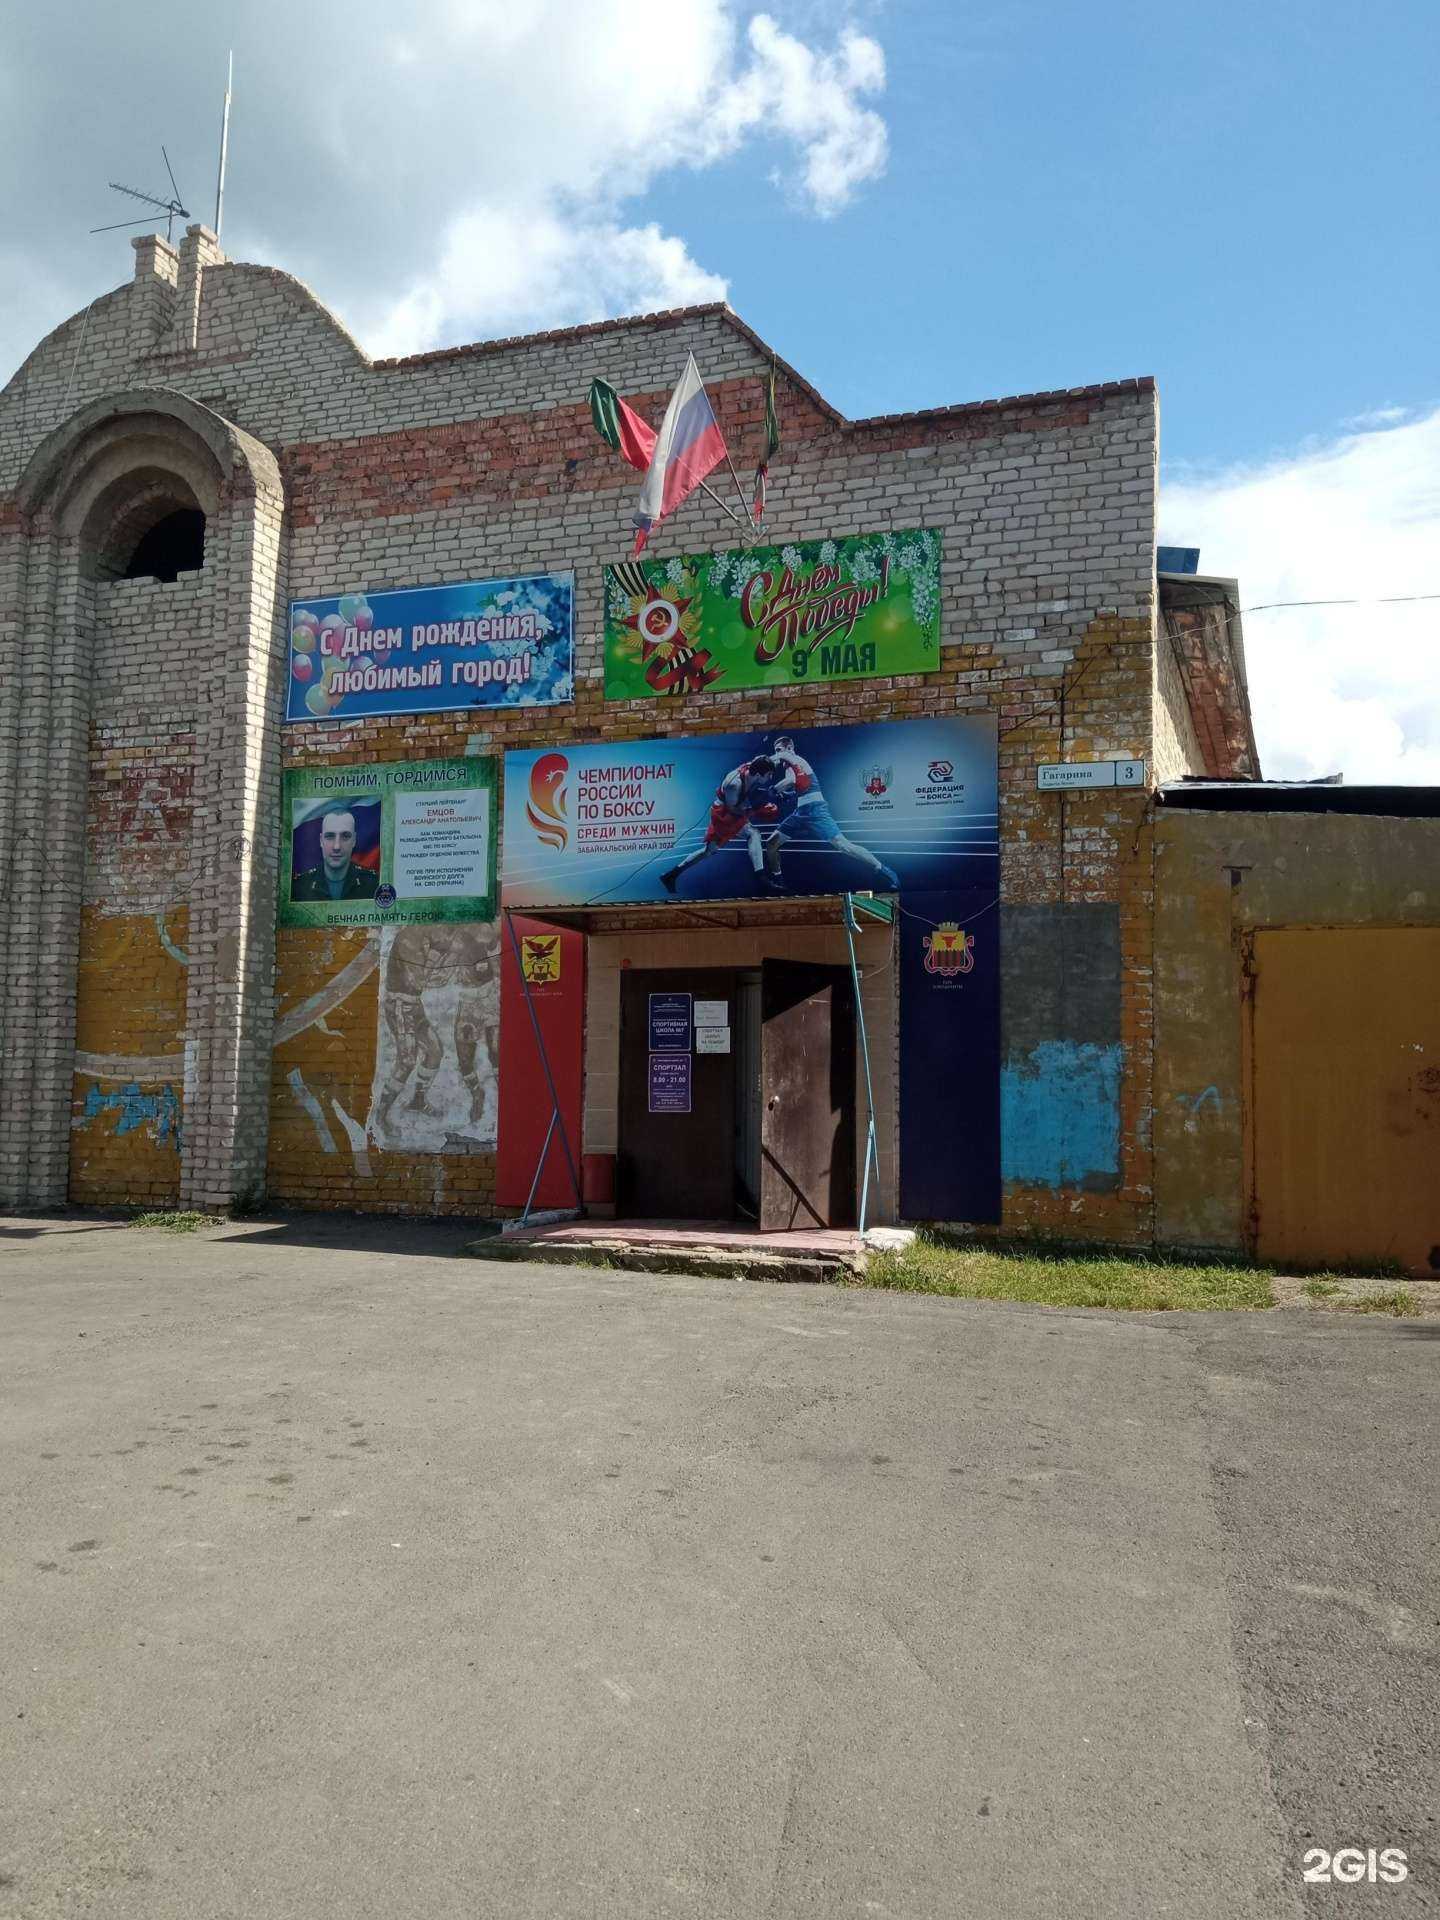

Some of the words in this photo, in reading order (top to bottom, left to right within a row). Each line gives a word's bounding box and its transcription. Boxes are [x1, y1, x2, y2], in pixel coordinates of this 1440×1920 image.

[742, 571, 775, 628] С
[320, 630, 333, 656] С
[341, 626, 402, 658] Днем
[412, 613, 544, 651] рождения,
[791, 649, 808, 678] 9
[821, 641, 877, 676] МАЯ
[327, 660, 442, 695] любимый
[452, 652, 531, 687] город!
[314, 774, 382, 790] ПОМНИМ,
[386, 767, 467, 785] ГОРДИМСЯ
[578, 763, 676, 784] ЧЕМПИОНАТ
[1042, 771, 1093, 781] Гагарина
[1125, 766, 1134, 780] 3
[578, 784, 642, 802] РОССИИ
[915, 784, 965, 795] ФЕДЕРАЦИЯ
[926, 793, 952, 801] БОКСА
[427, 808, 455, 817] ЕМЦОВ
[578, 804, 599, 820] ПО
[603, 800, 656, 818] БОКСУ
[400, 817, 436, 826] АЛЕКСАНДР
[437, 815, 482, 824] АНАТОЛЬЕВИЧ
[577, 827, 617, 839] СРЕДИ
[621, 823, 675, 836] МУЖЧИН
[577, 844, 637, 854] ЗАБАЙКАЛЬСКИЙ
[638, 842, 658, 851] КРАЙ
[327, 914, 366, 924] ВЕЧНАЯ
[368, 913, 408, 923] ПАМЯТЬ
